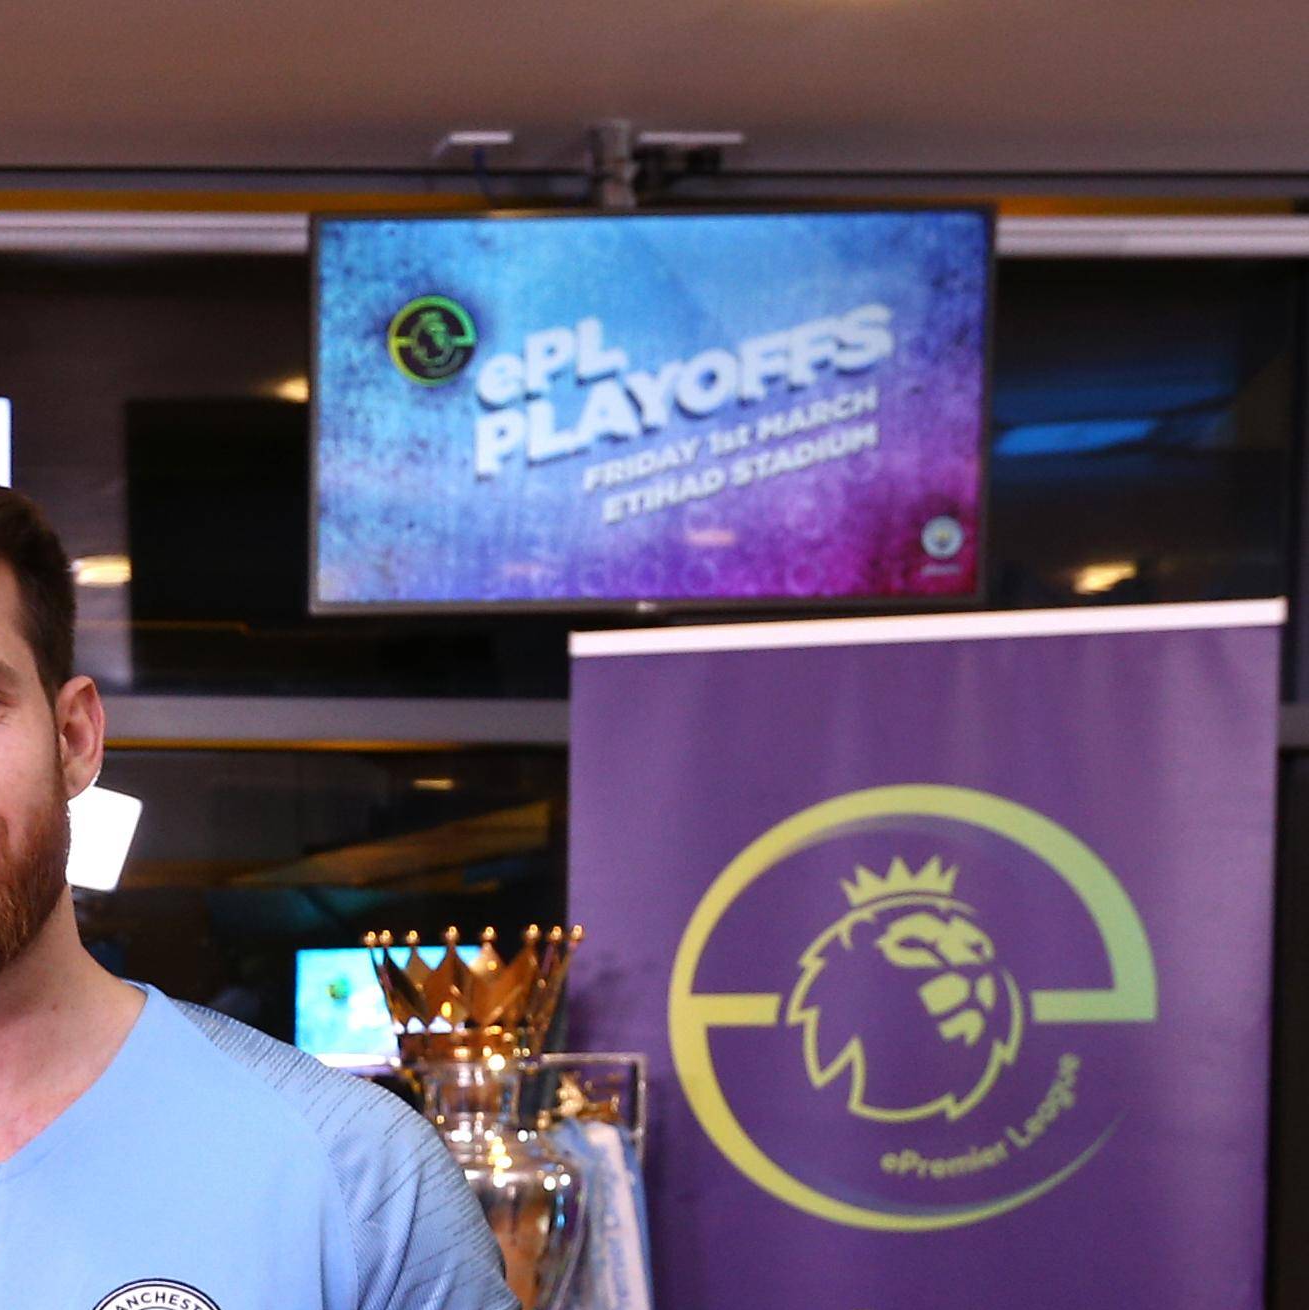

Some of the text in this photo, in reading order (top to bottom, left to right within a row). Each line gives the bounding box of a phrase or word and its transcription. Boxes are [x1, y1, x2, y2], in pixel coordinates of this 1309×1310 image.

[474, 303, 895, 478] PLAYOFFS
[477, 316, 629, 406] ePL
[584, 387, 880, 491] FRIDAY 1st MARCH
[601, 423, 880, 524] ETIHAD STADIUM
[880, 1053, 1080, 1179] ePremier League
